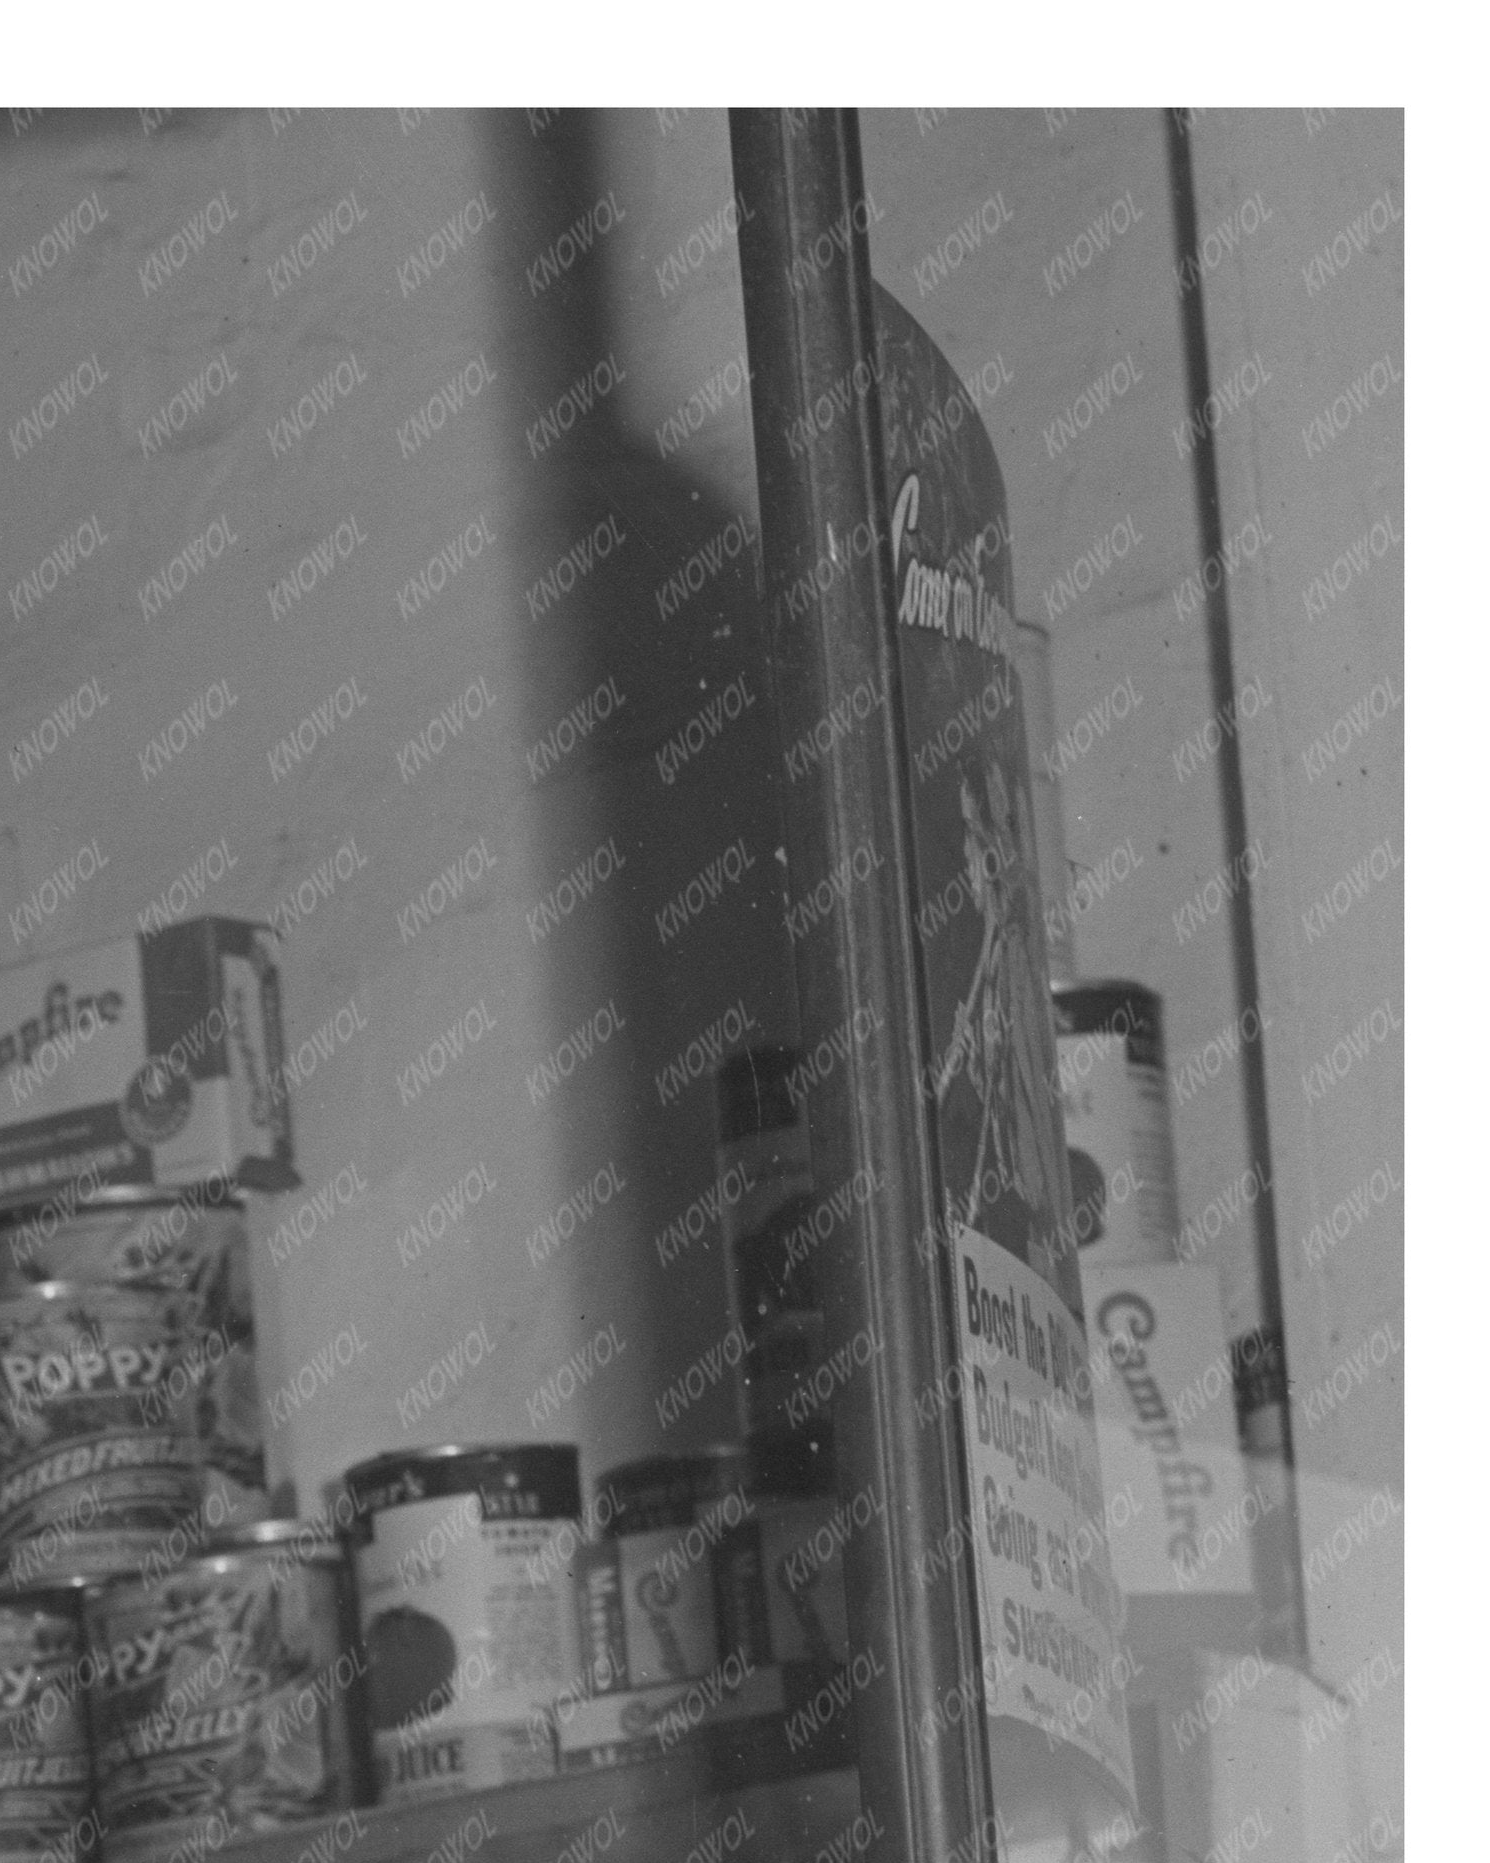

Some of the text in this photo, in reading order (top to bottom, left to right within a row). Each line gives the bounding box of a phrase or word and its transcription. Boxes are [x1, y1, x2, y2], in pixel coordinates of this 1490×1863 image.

[1, 1344, 168, 1398] POPPY
[962, 1254, 1019, 1358] Boost
[1021, 1292, 1048, 1381] the
[1096, 1290, 1212, 1562] Campfire
